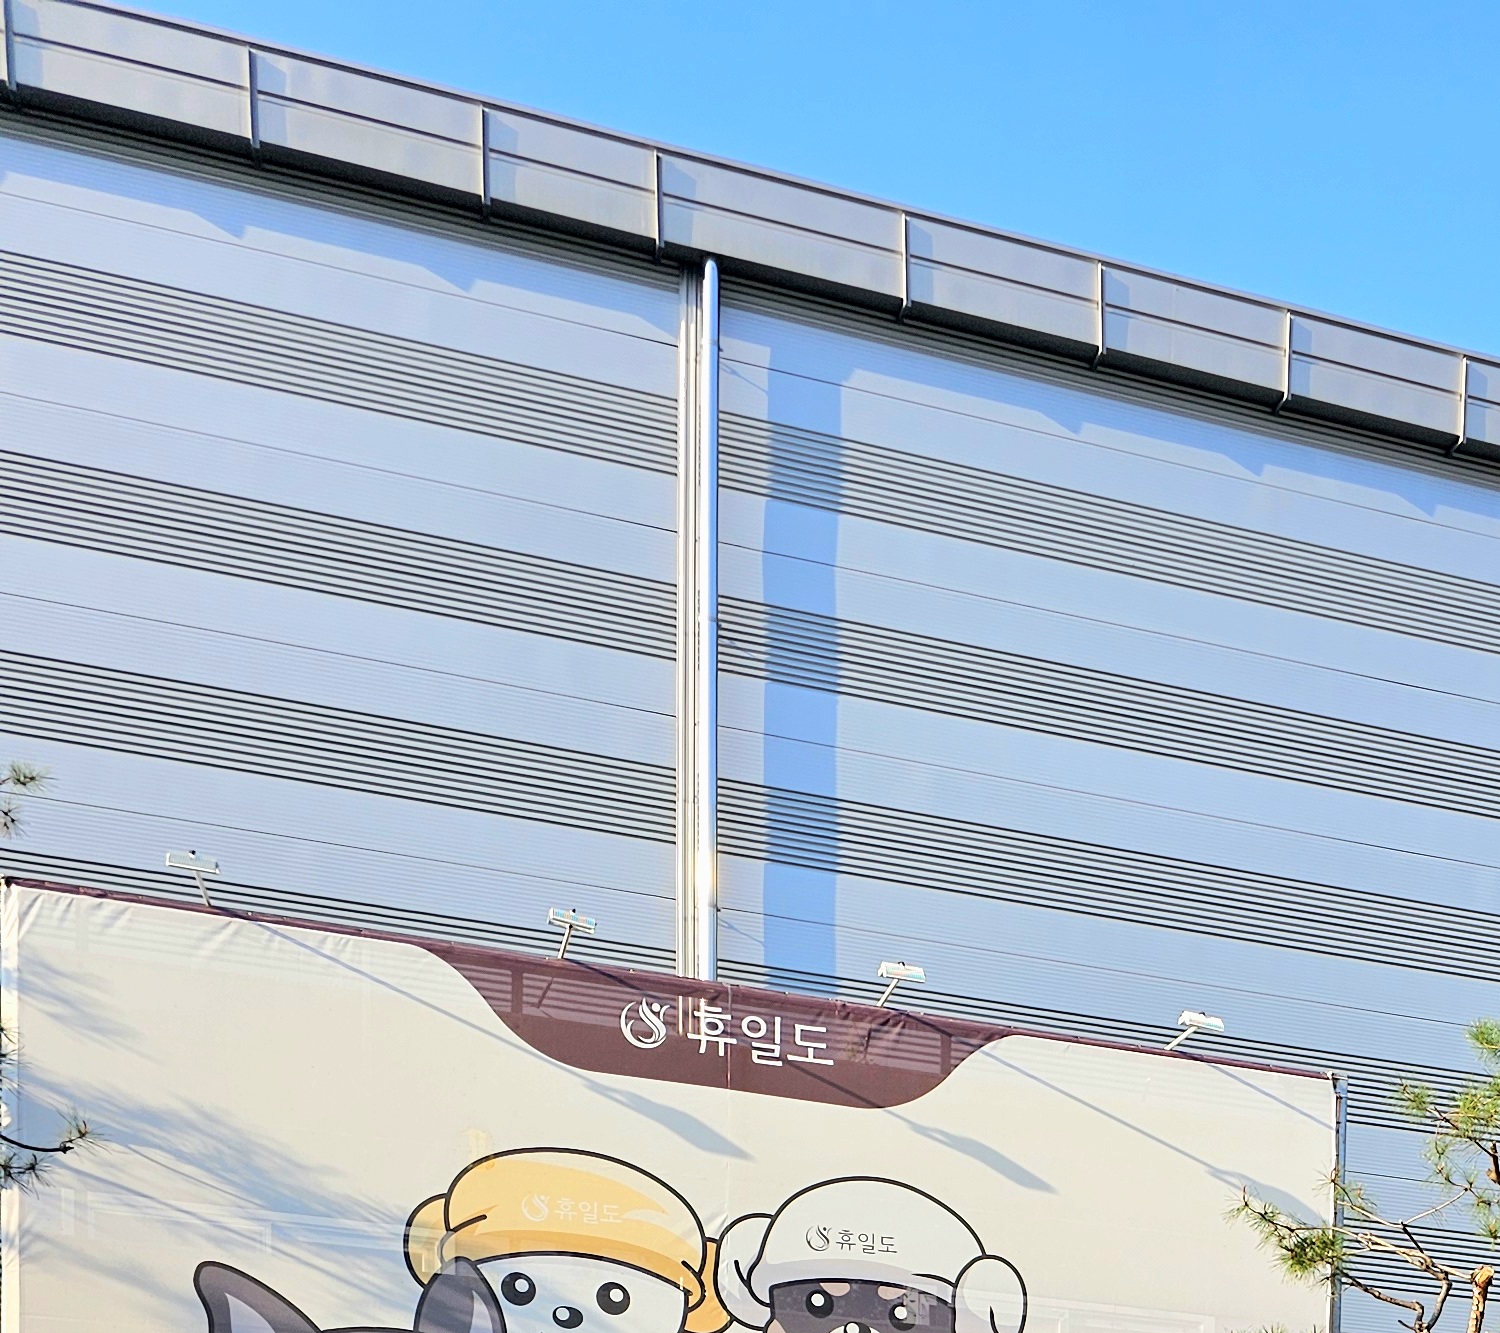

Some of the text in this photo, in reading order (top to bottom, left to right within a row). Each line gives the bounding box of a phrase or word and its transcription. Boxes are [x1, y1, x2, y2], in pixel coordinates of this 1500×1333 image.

[687, 1004, 835, 1067] 휴일도
[554, 1197, 623, 1225] 휴일도
[836, 1229, 898, 1255] 휴일도
